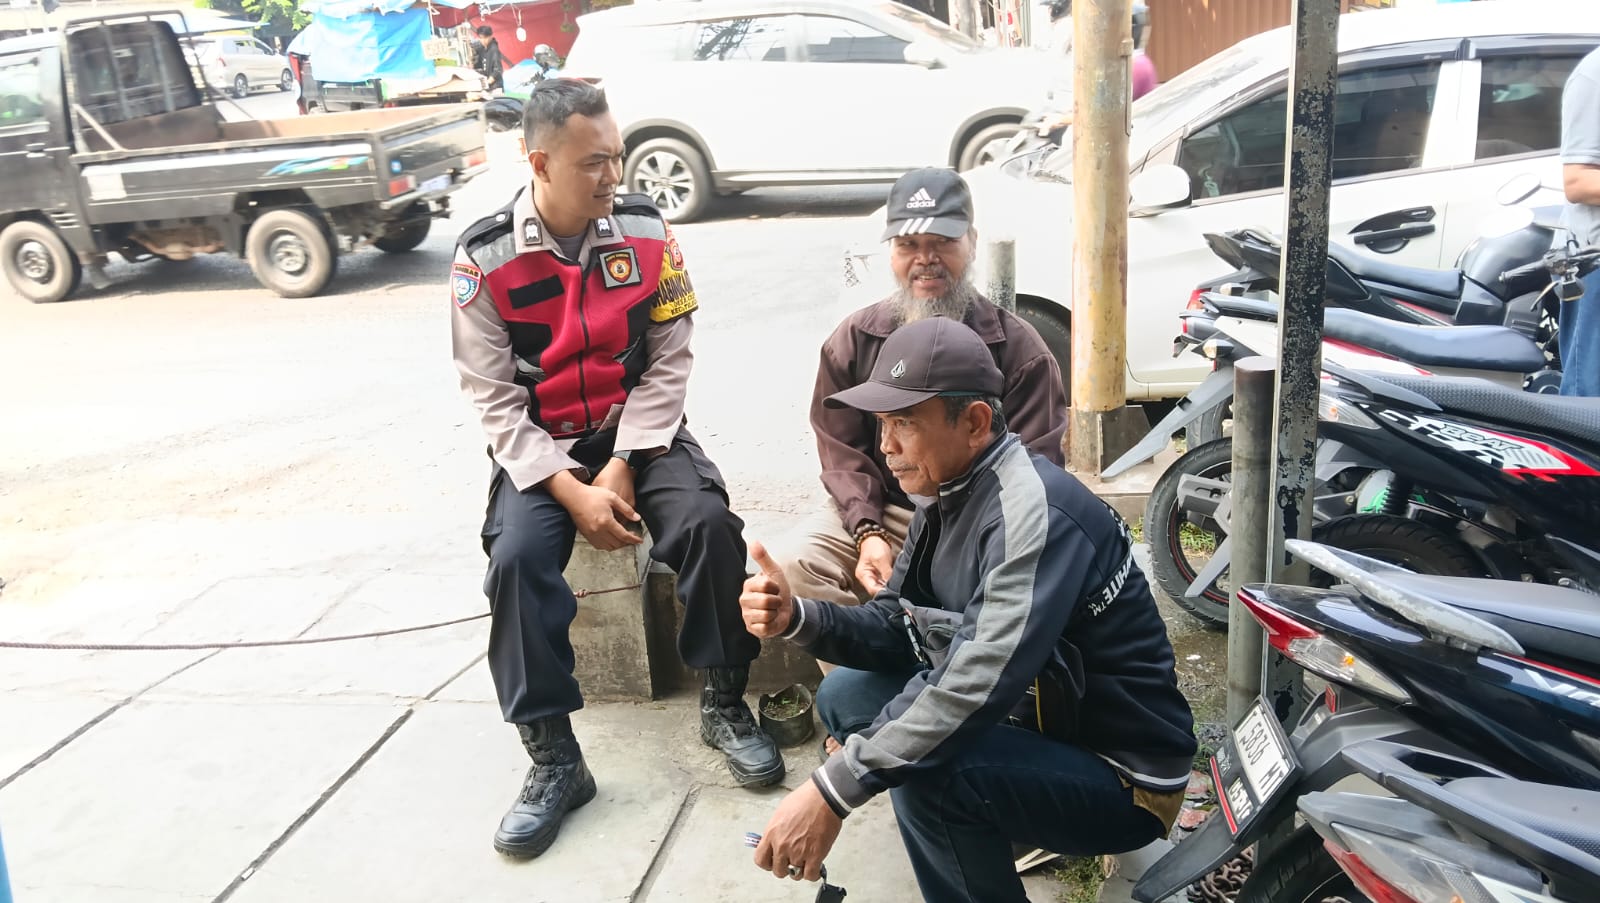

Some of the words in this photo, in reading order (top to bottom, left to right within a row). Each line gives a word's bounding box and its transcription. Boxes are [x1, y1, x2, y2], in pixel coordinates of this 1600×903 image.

[906, 199, 936, 209] adidas
[1239, 721, 1271, 767] 5836
[1259, 761, 1284, 797] MT
